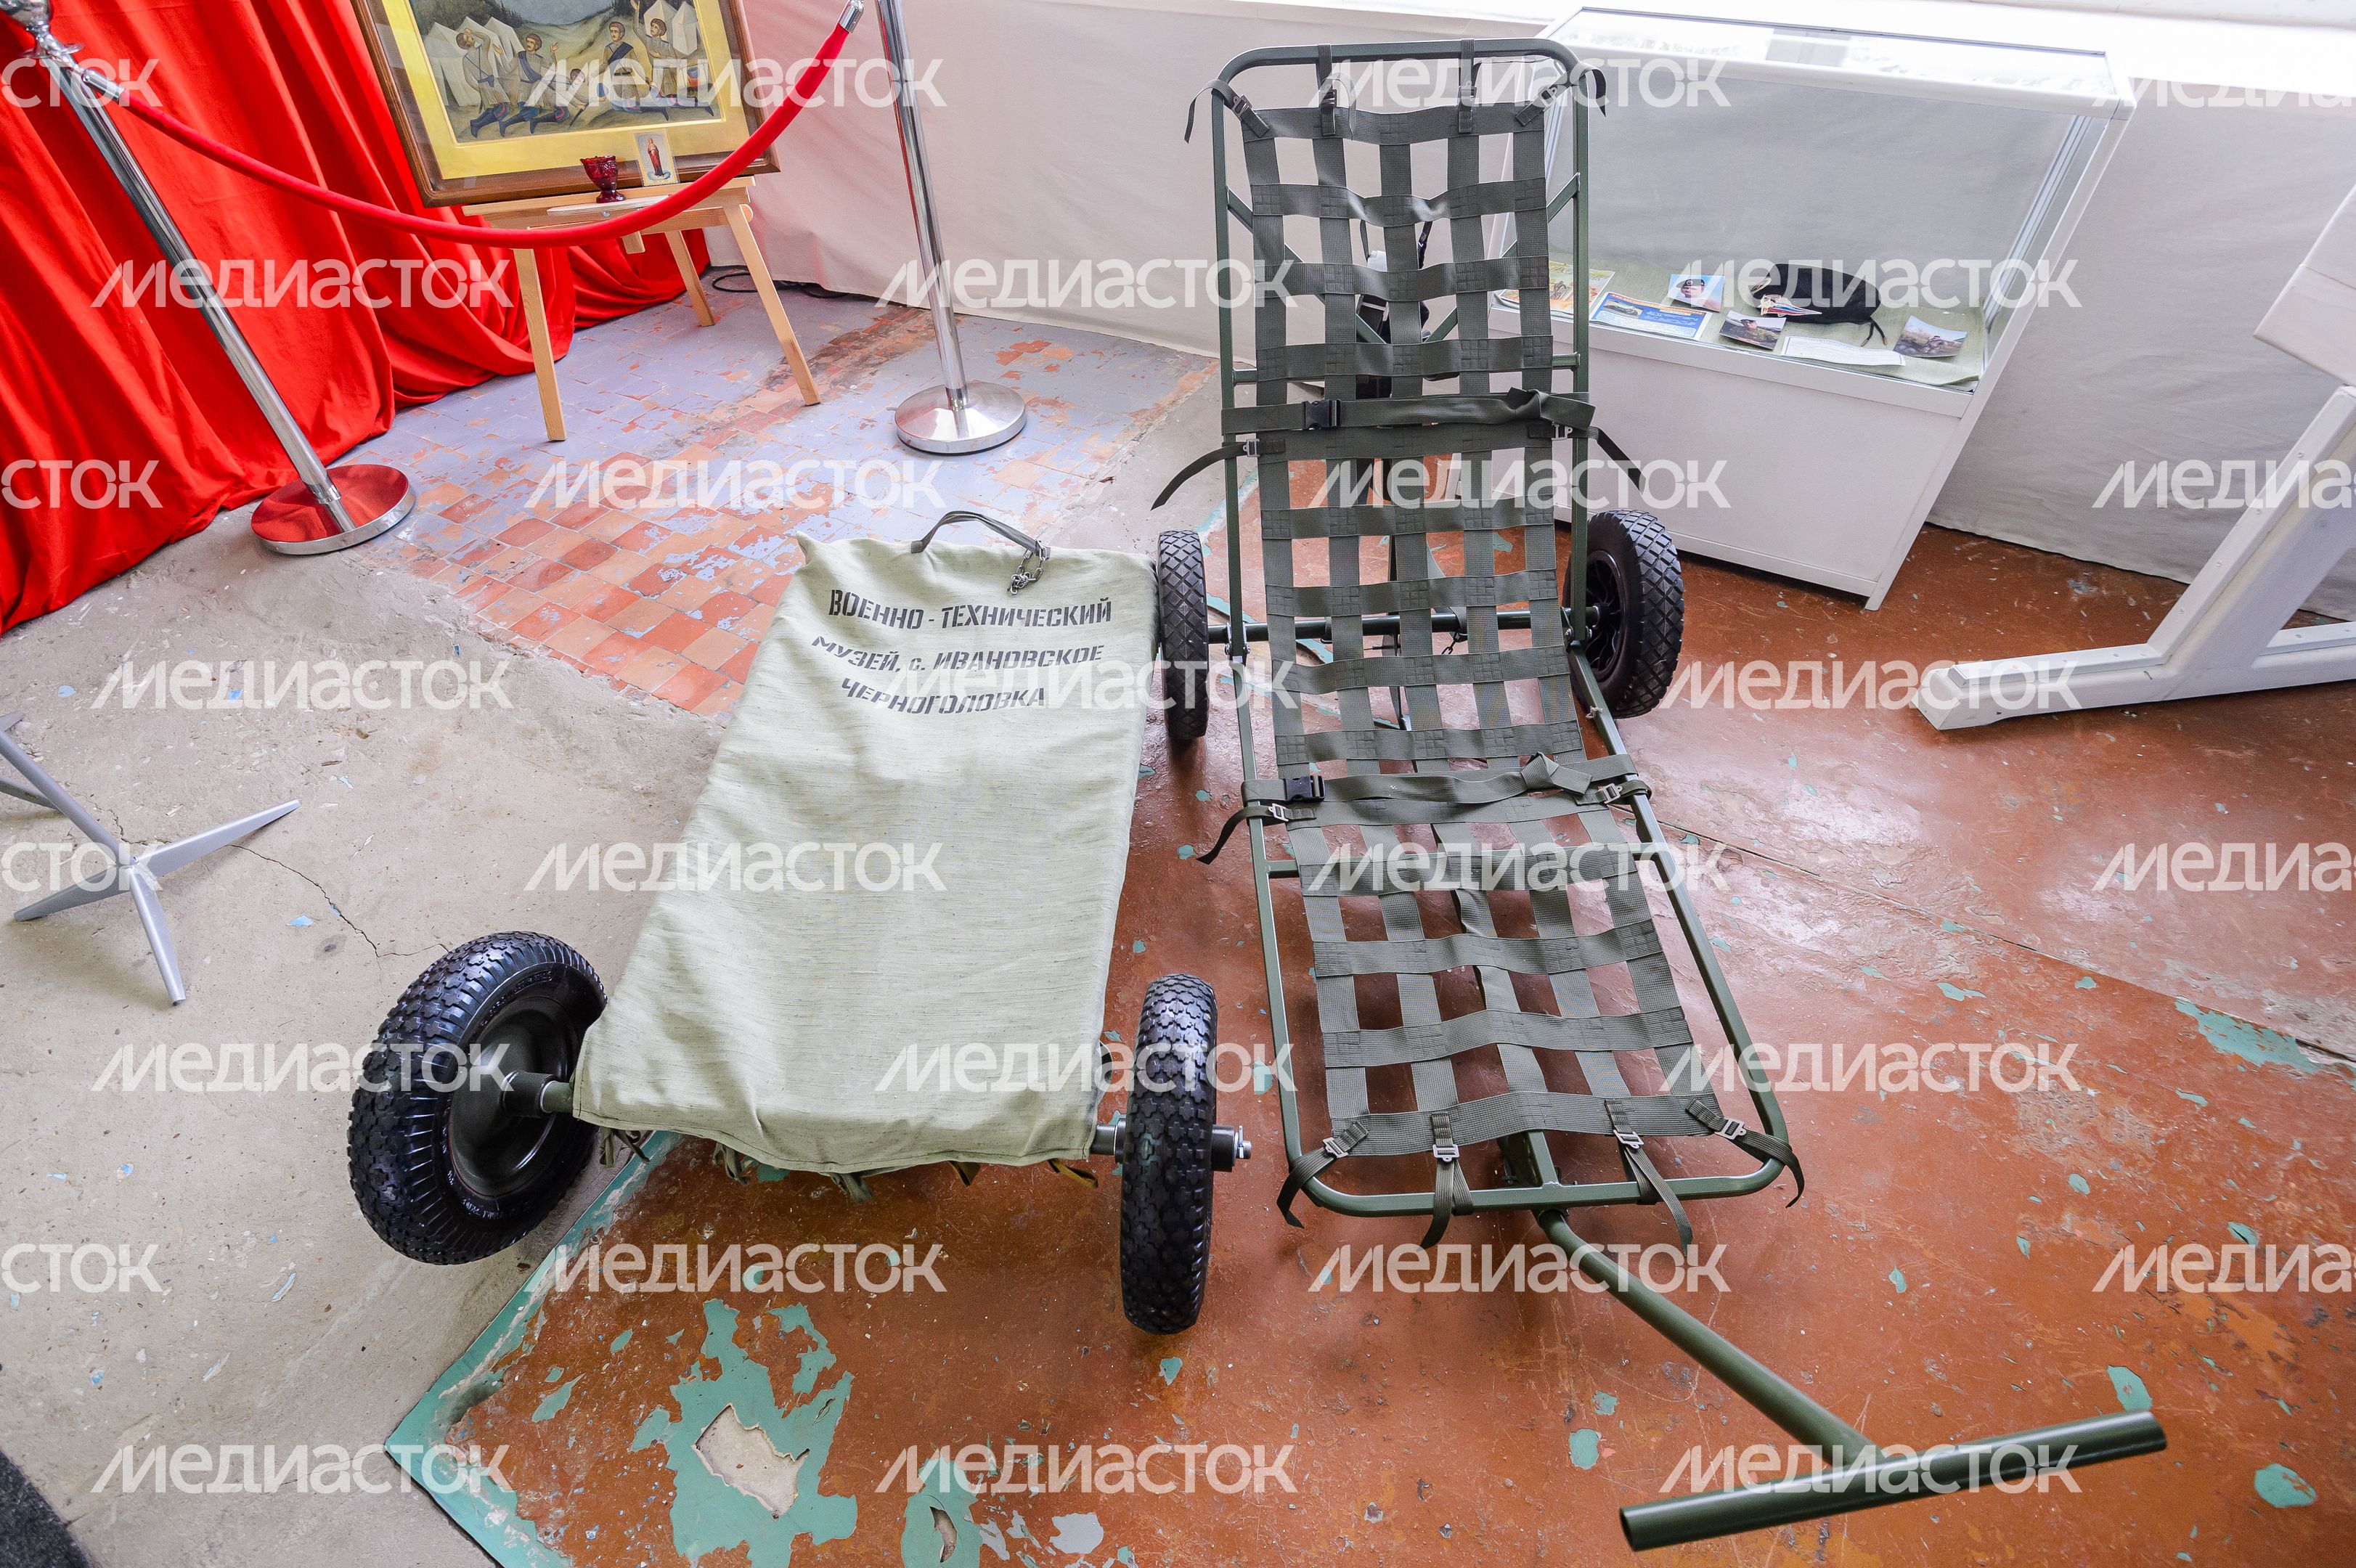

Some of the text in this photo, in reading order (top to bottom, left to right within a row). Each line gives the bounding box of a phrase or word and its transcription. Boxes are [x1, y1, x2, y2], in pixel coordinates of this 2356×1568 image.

[828, 589, 924, 629] ВОЕННО
[941, 597, 1112, 629] ТЕХНИЧЕСКИЙ
[812, 635, 900, 673] МУЗЕЙ,
[934, 645, 1105, 672] ИВАНОВСКОЕ
[841, 677, 1045, 714] ЧЕРНОГОЛОВКА
